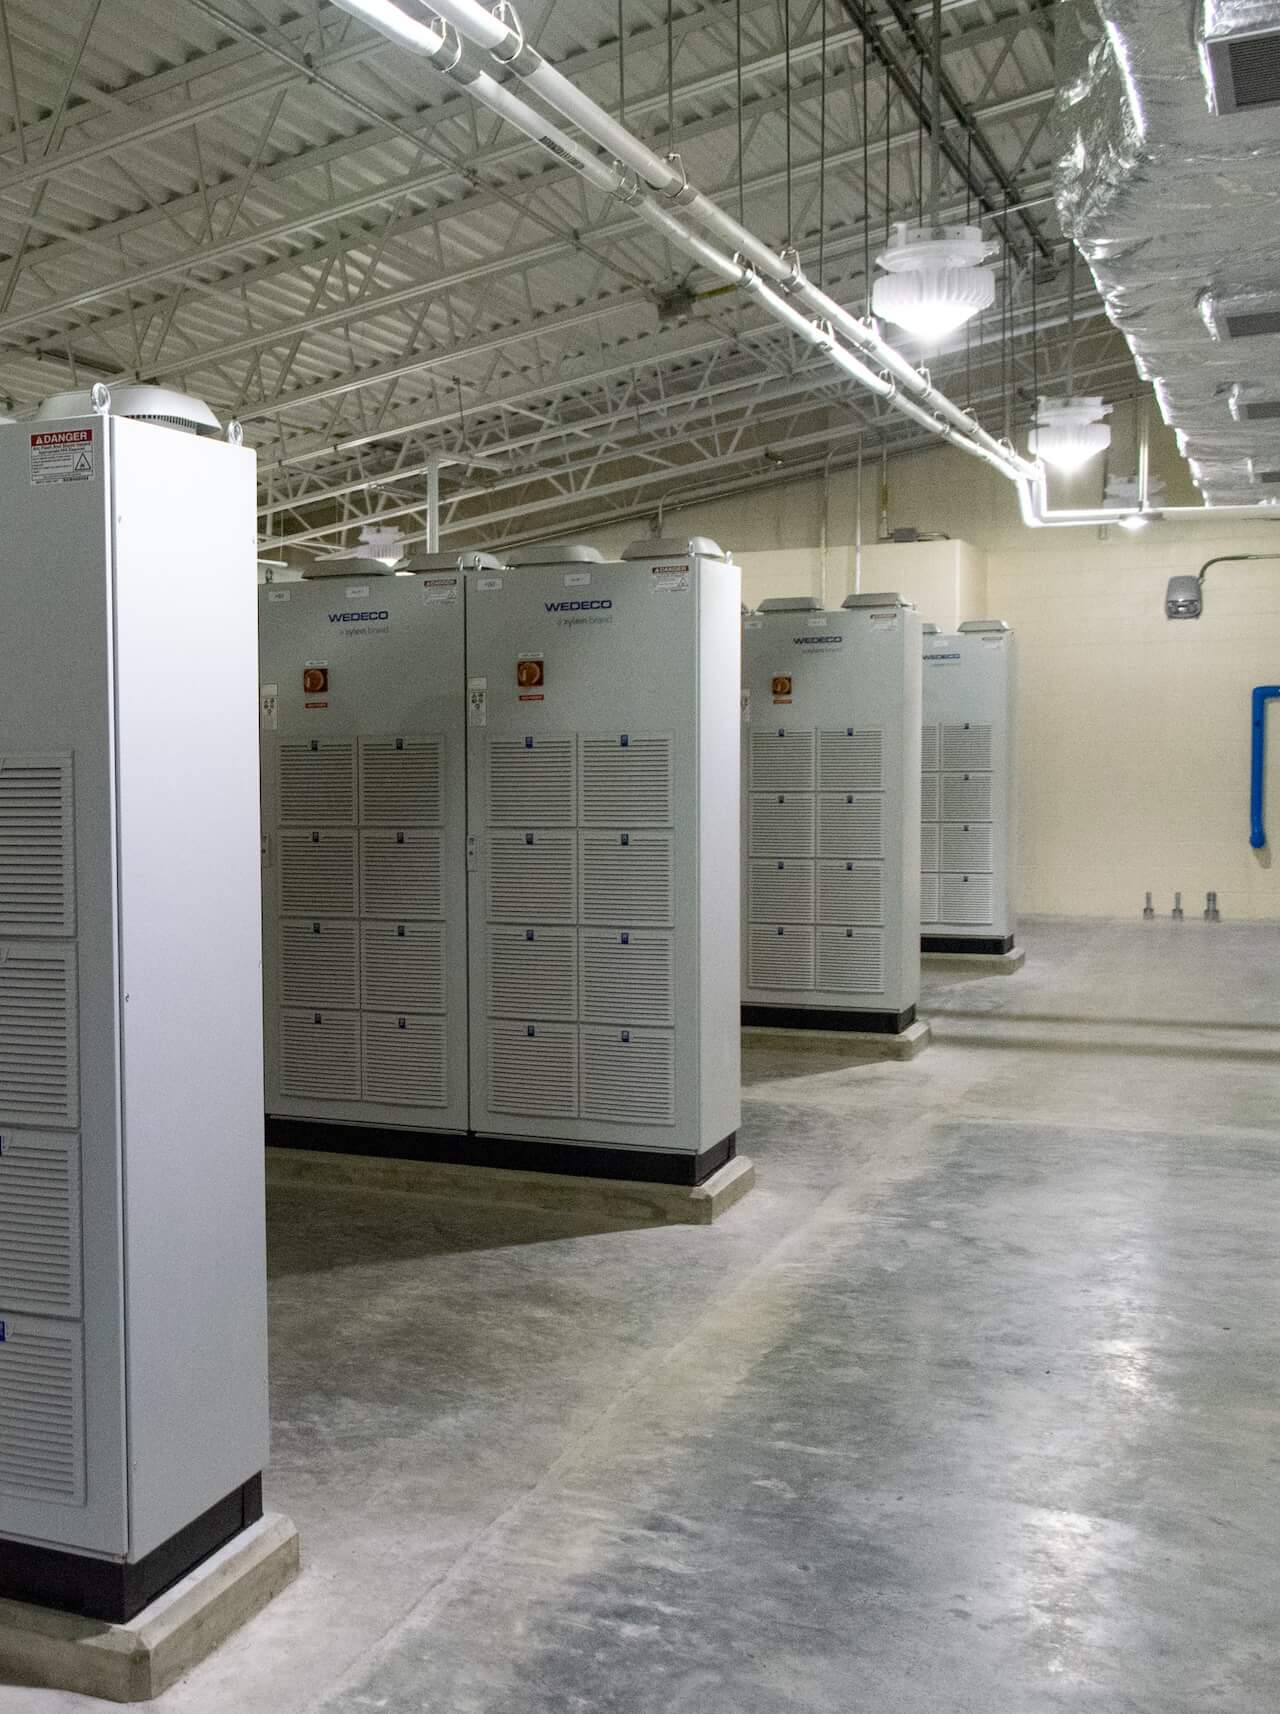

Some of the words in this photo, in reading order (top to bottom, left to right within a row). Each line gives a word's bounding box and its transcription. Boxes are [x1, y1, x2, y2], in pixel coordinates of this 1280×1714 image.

[44, 432, 88, 444] DANGER
[544, 600, 612, 612] WEDECO
[328, 610, 389, 622] WEDECO
[793, 635, 842, 645] WEDECO
[922, 653, 960, 661] WEDECO
